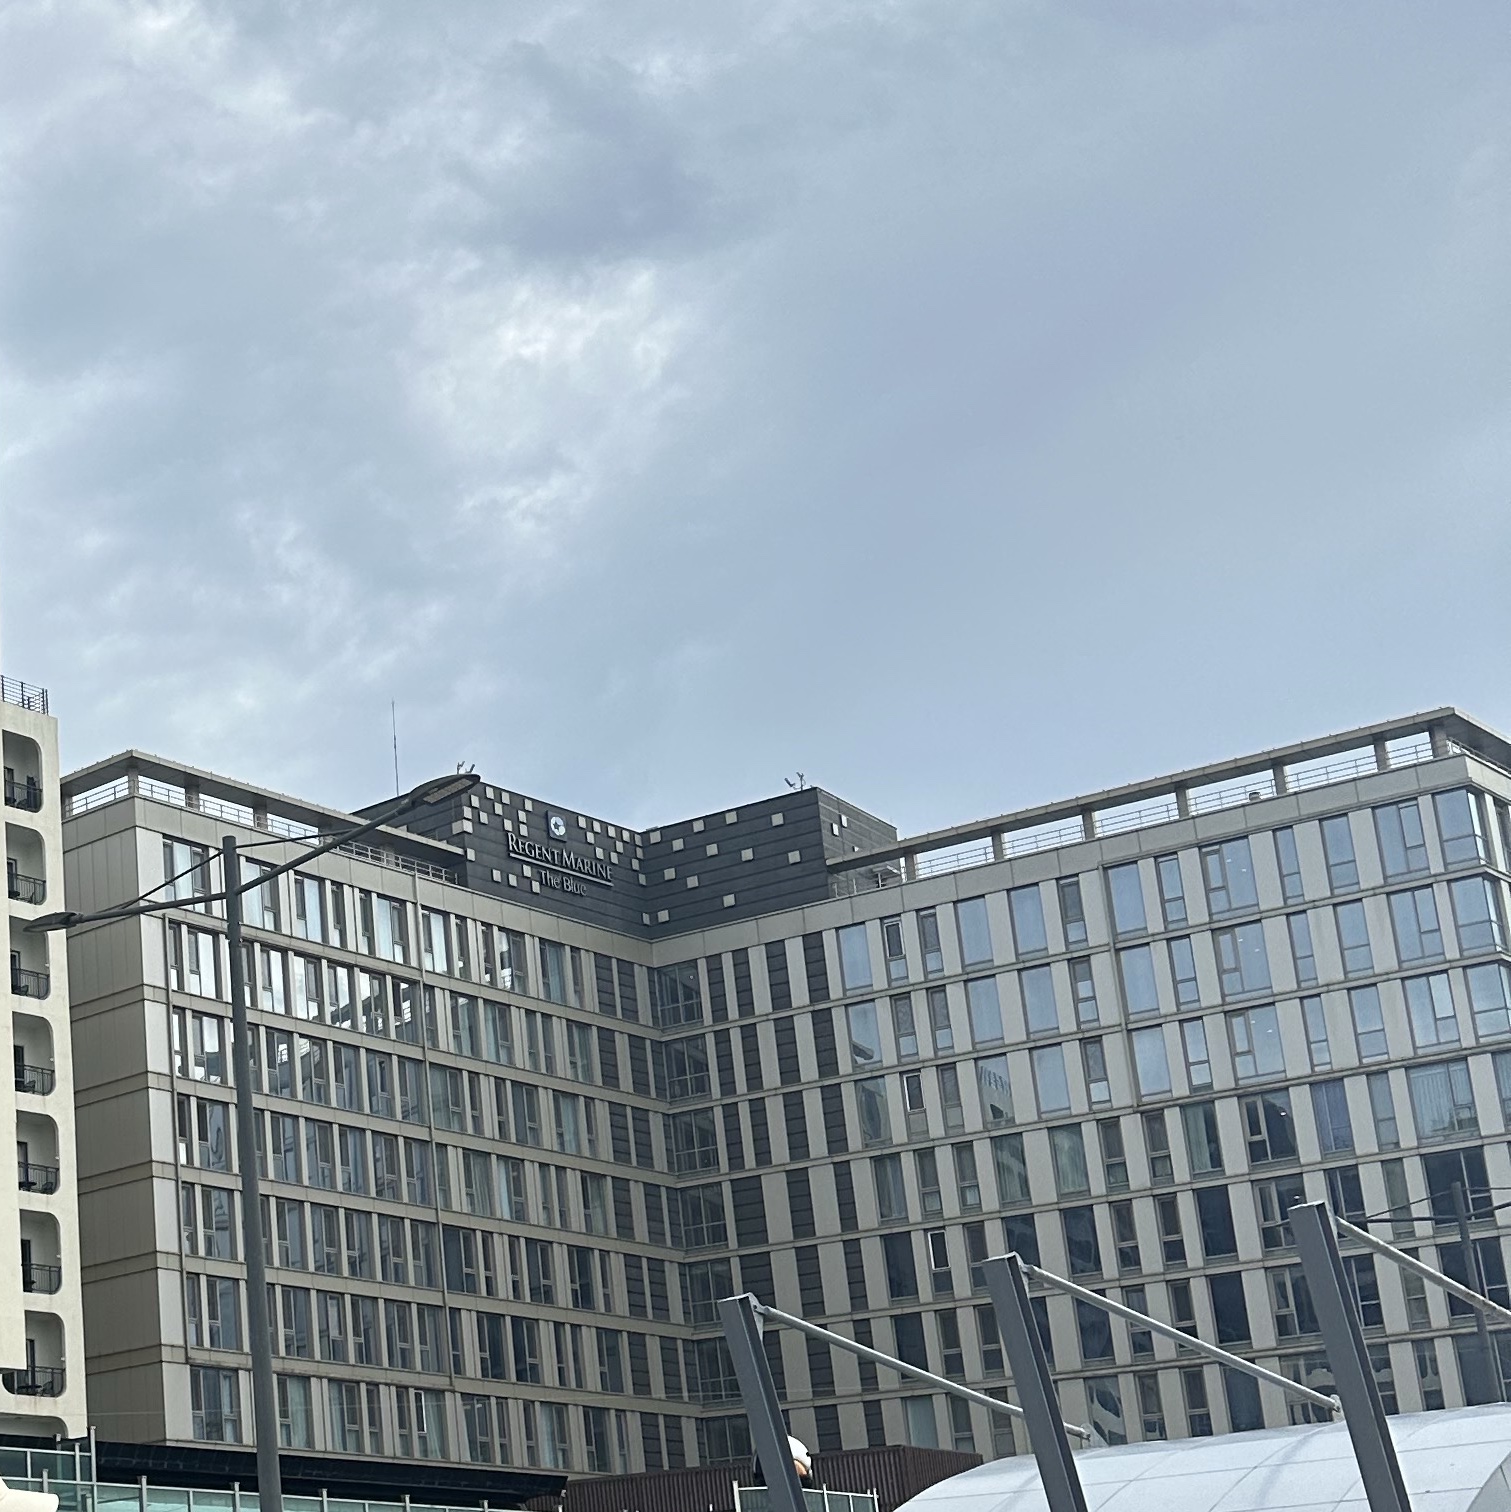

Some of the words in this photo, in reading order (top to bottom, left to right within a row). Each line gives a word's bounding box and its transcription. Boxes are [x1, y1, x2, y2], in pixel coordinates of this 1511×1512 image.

[507, 832, 559, 866] REGENT
[561, 848, 614, 880] MARINE
[539, 869, 561, 888] The
[562, 876, 587, 896] Blue
